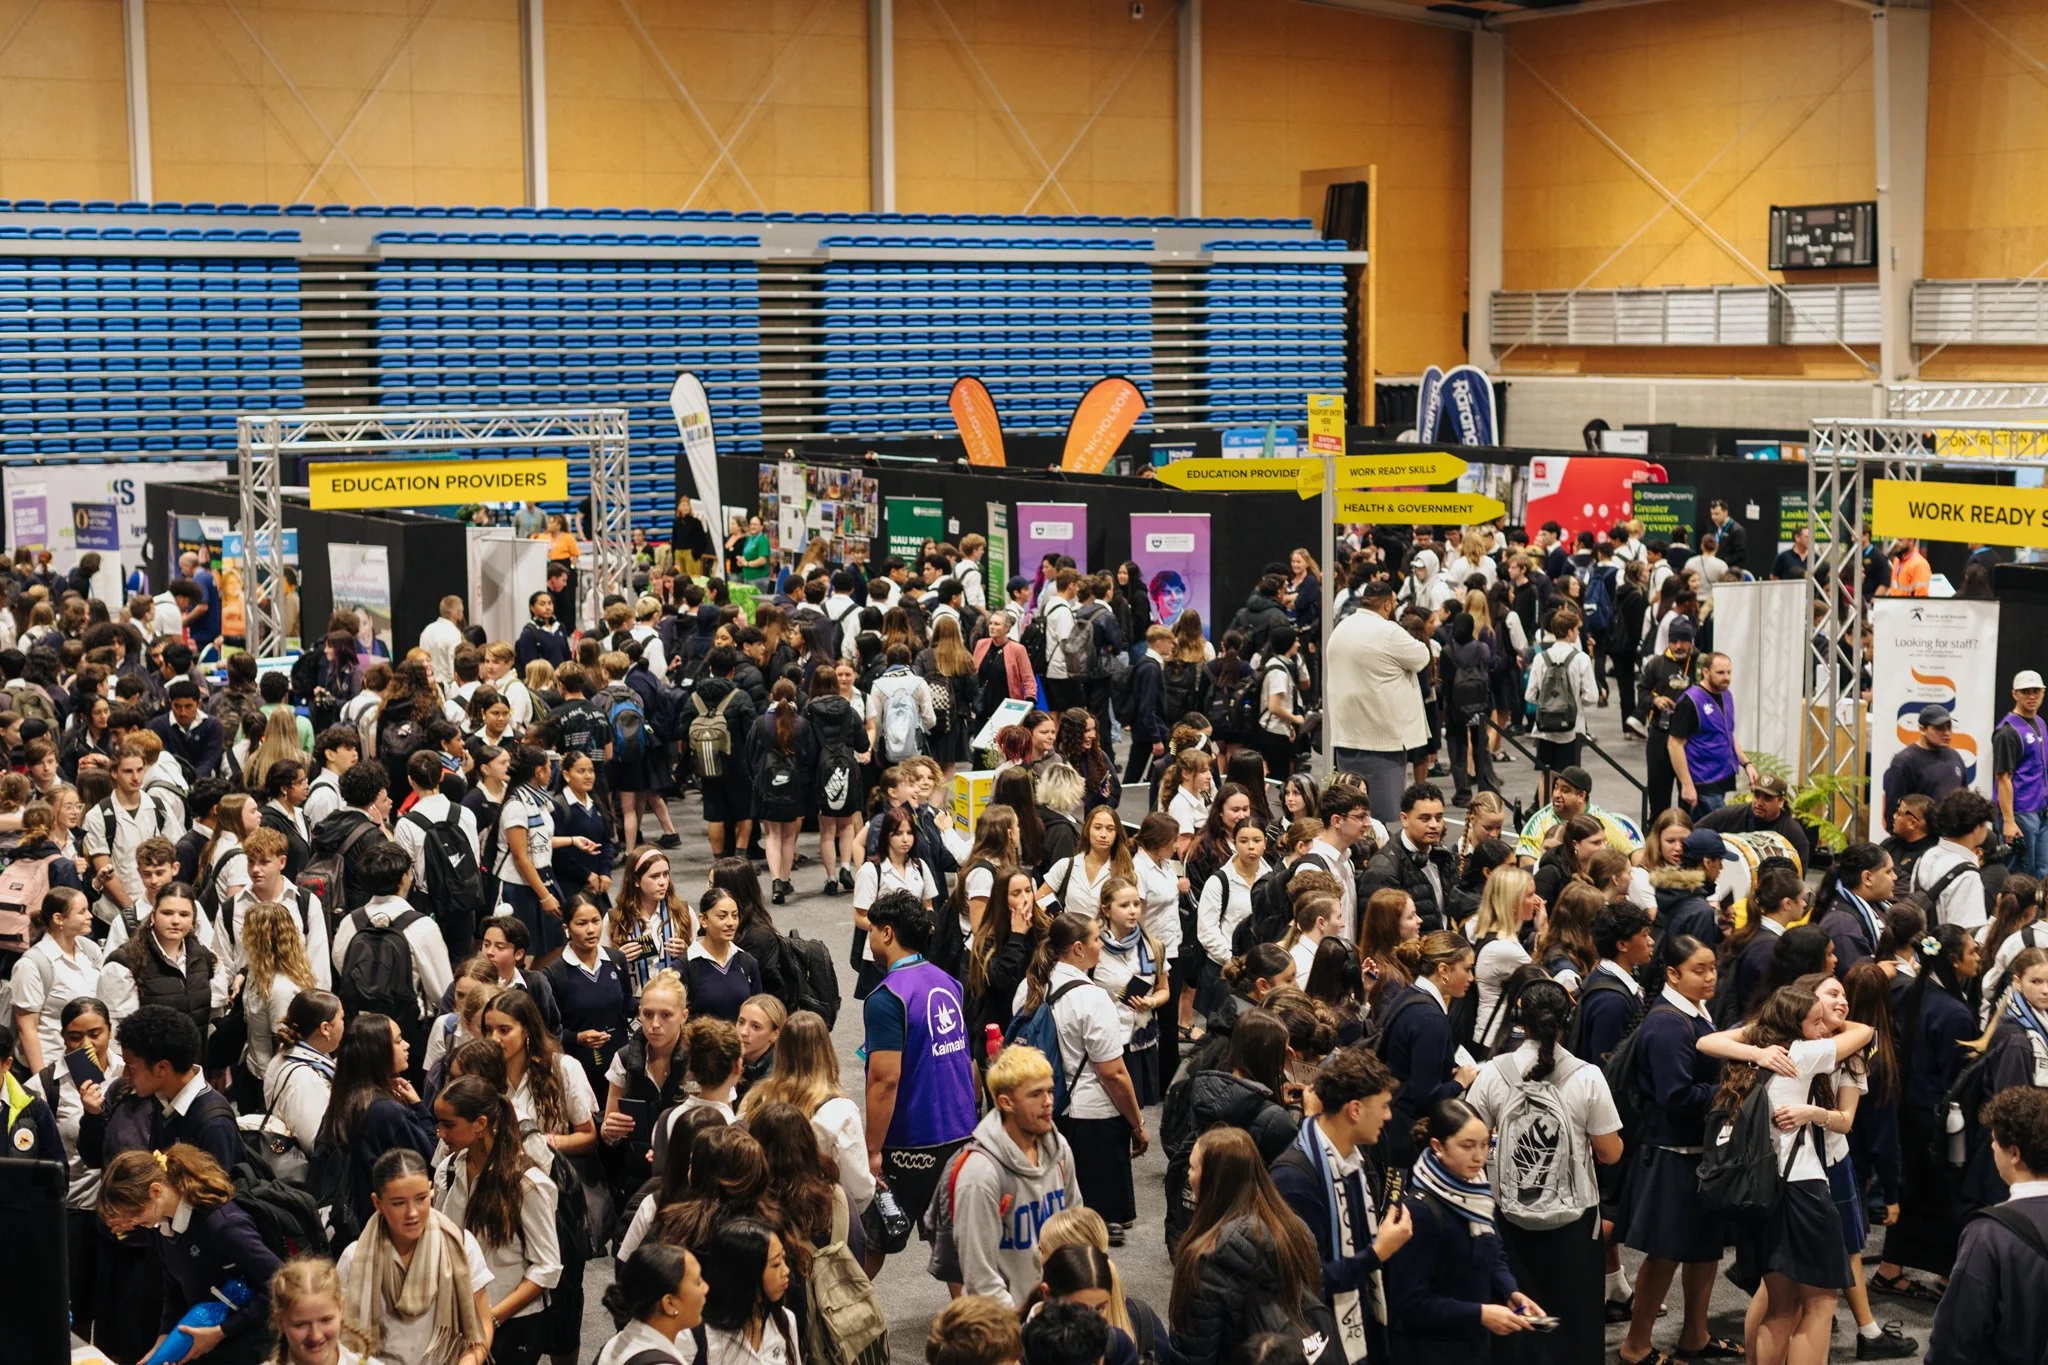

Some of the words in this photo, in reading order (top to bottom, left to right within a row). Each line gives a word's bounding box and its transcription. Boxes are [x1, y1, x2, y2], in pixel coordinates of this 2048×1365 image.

[1084, 387, 1132, 456] NICHOLSON
[1187, 470, 1248, 478] EDUCATION
[1350, 467, 1376, 477] WORK
[1378, 466, 1407, 475] READY
[1409, 465, 1436, 474] SKILLS
[331, 476, 441, 493] EDUCATION
[446, 472, 547, 490] PROVIDERS
[1344, 504, 1383, 513] HEALTH
[1386, 504, 1395, 513] &
[1397, 504, 1474, 513] GOVERNMENT
[1634, 504, 1669, 513] Greater
[1908, 501, 1965, 521] WORK
[1971, 505, 2036, 526] READY
[1634, 514, 1679, 522] outcomes
[890, 535, 908, 544] NAU
[890, 546, 917, 555] HAERE
[1895, 637, 1933, 649] Looking
[1935, 638, 1950, 648] for
[1951, 638, 1978, 649] staff?
[932, 1036, 966, 1057] Kaimahi
